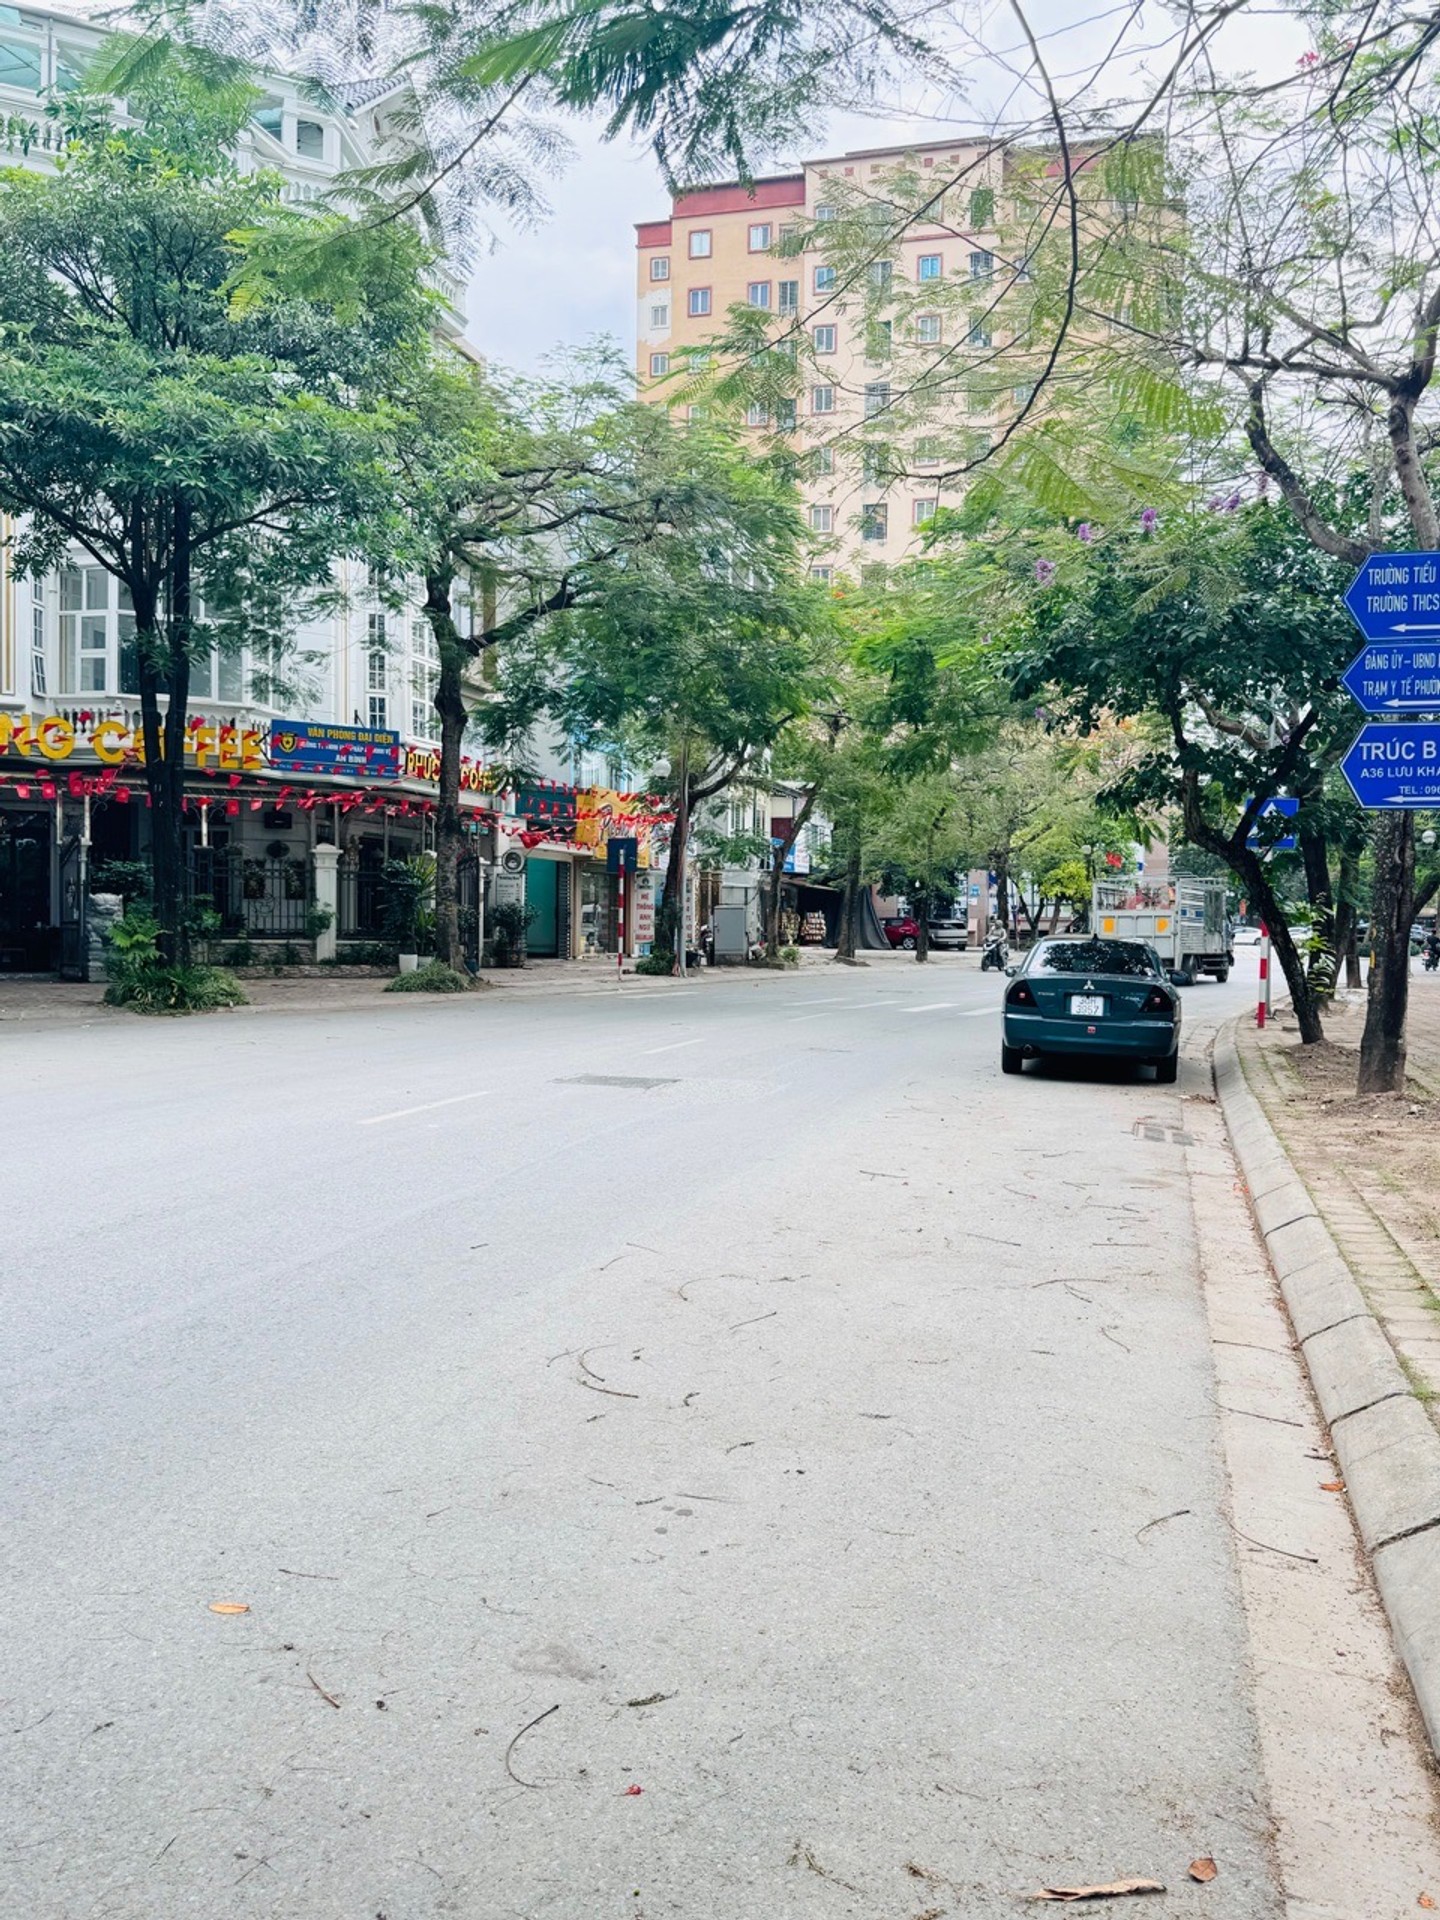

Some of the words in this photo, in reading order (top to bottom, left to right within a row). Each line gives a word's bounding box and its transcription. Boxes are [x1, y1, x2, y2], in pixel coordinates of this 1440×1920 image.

[1368, 563, 1409, 586] TRƯỜNG
[1367, 590, 1408, 613] TRƯỜNG
[1412, 594, 1440, 611] THCS
[1365, 650, 1389, 670] ĐẢNG
[1413, 653, 1436, 668] UBND
[1363, 680, 1388, 700] TRẠM
[1391, 680, 1397, 695] Y
[1401, 675, 1414, 695] TẾ
[327, 729, 356, 741] PHÒNG
[1359, 737, 1415, 760] TRÚC
[1423, 740, 1437, 759] B
[1361, 768, 1384, 778] A36
[1387, 766, 1413, 778] LƯU
